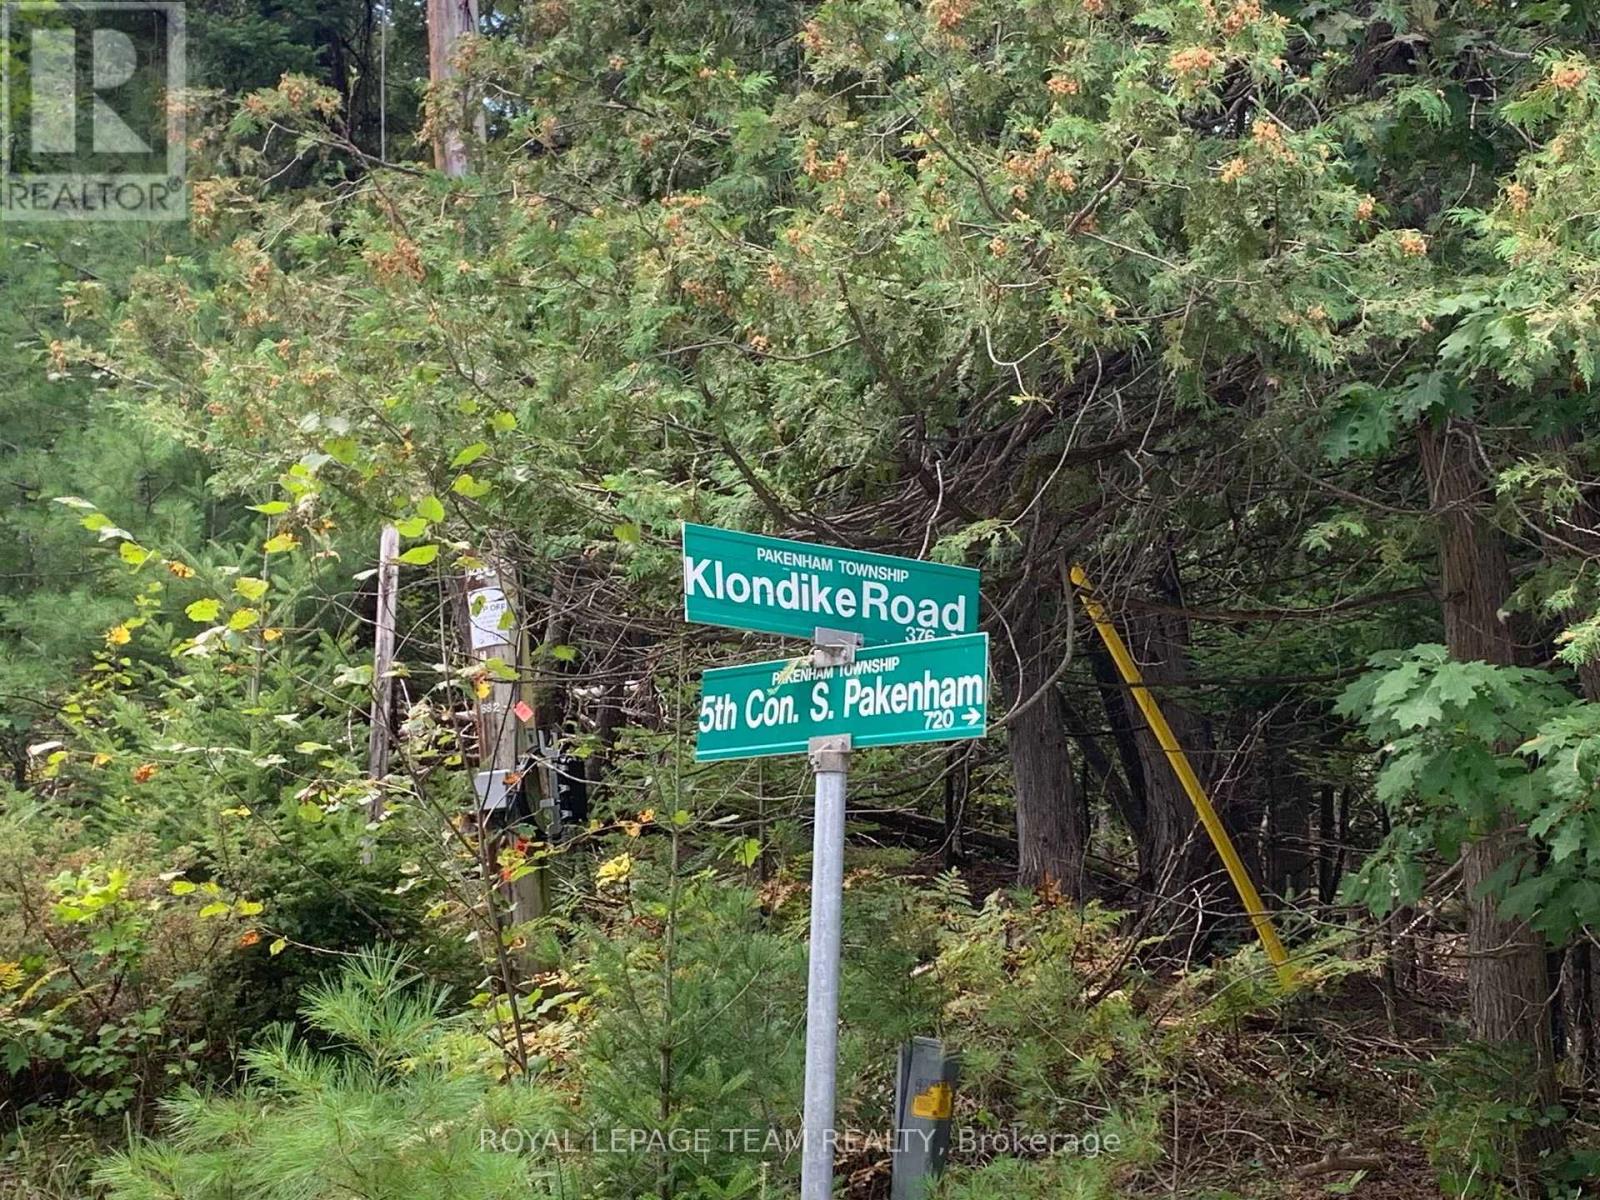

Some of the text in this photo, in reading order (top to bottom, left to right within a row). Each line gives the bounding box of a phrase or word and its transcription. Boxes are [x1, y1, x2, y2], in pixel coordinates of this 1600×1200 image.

[756, 547, 910, 583] PAKENHAM TOWNSHIP
[685, 556, 966, 632] Klondike Road
[905, 626, 936, 643] 376
[839, 656, 900, 678] TOWNSHIP
[699, 670, 983, 733] 5th Con. S. Pakenham
[923, 709, 955, 730] 720
